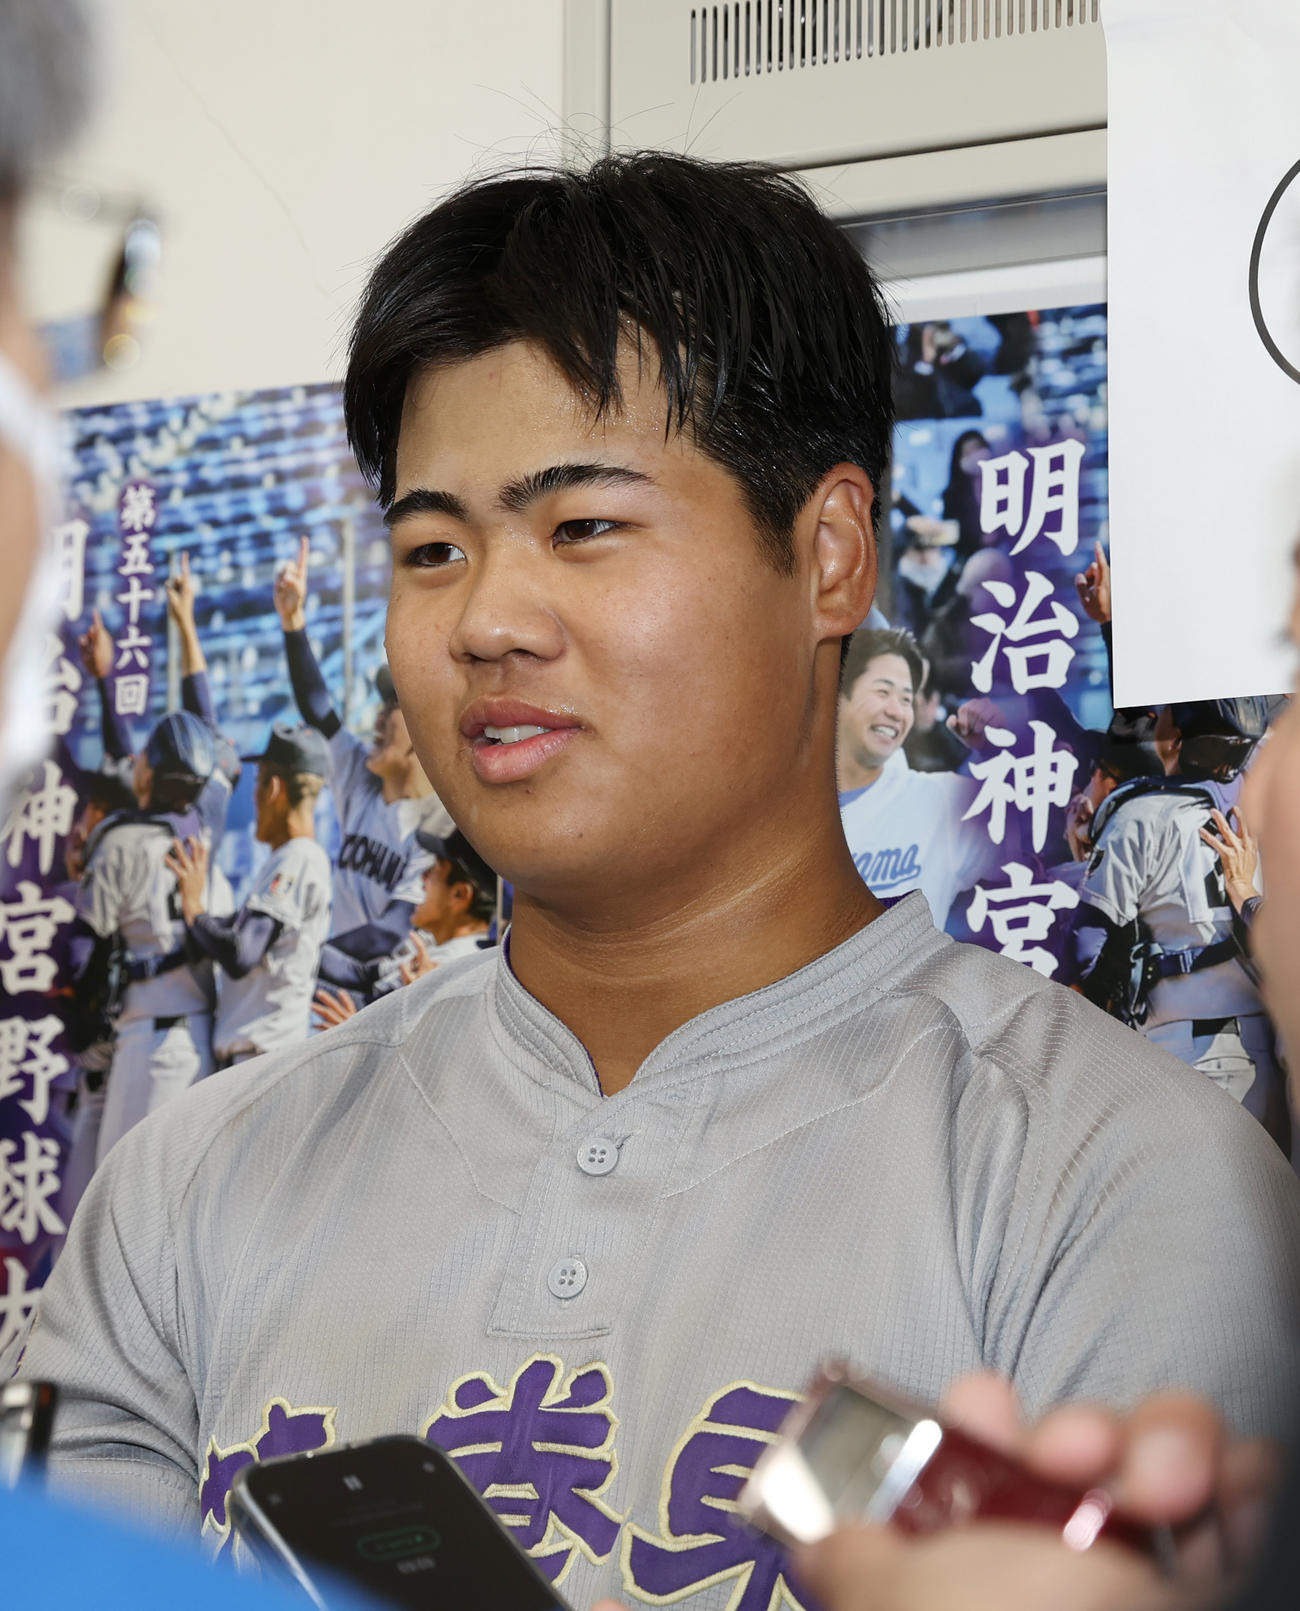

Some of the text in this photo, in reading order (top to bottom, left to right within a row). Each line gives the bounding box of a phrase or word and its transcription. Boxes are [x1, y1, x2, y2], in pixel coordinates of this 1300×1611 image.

[115, 484, 156, 717] 第五十六回
[961, 438, 1086, 978] 明治神宮
[852, 844, 922, 891] ama
